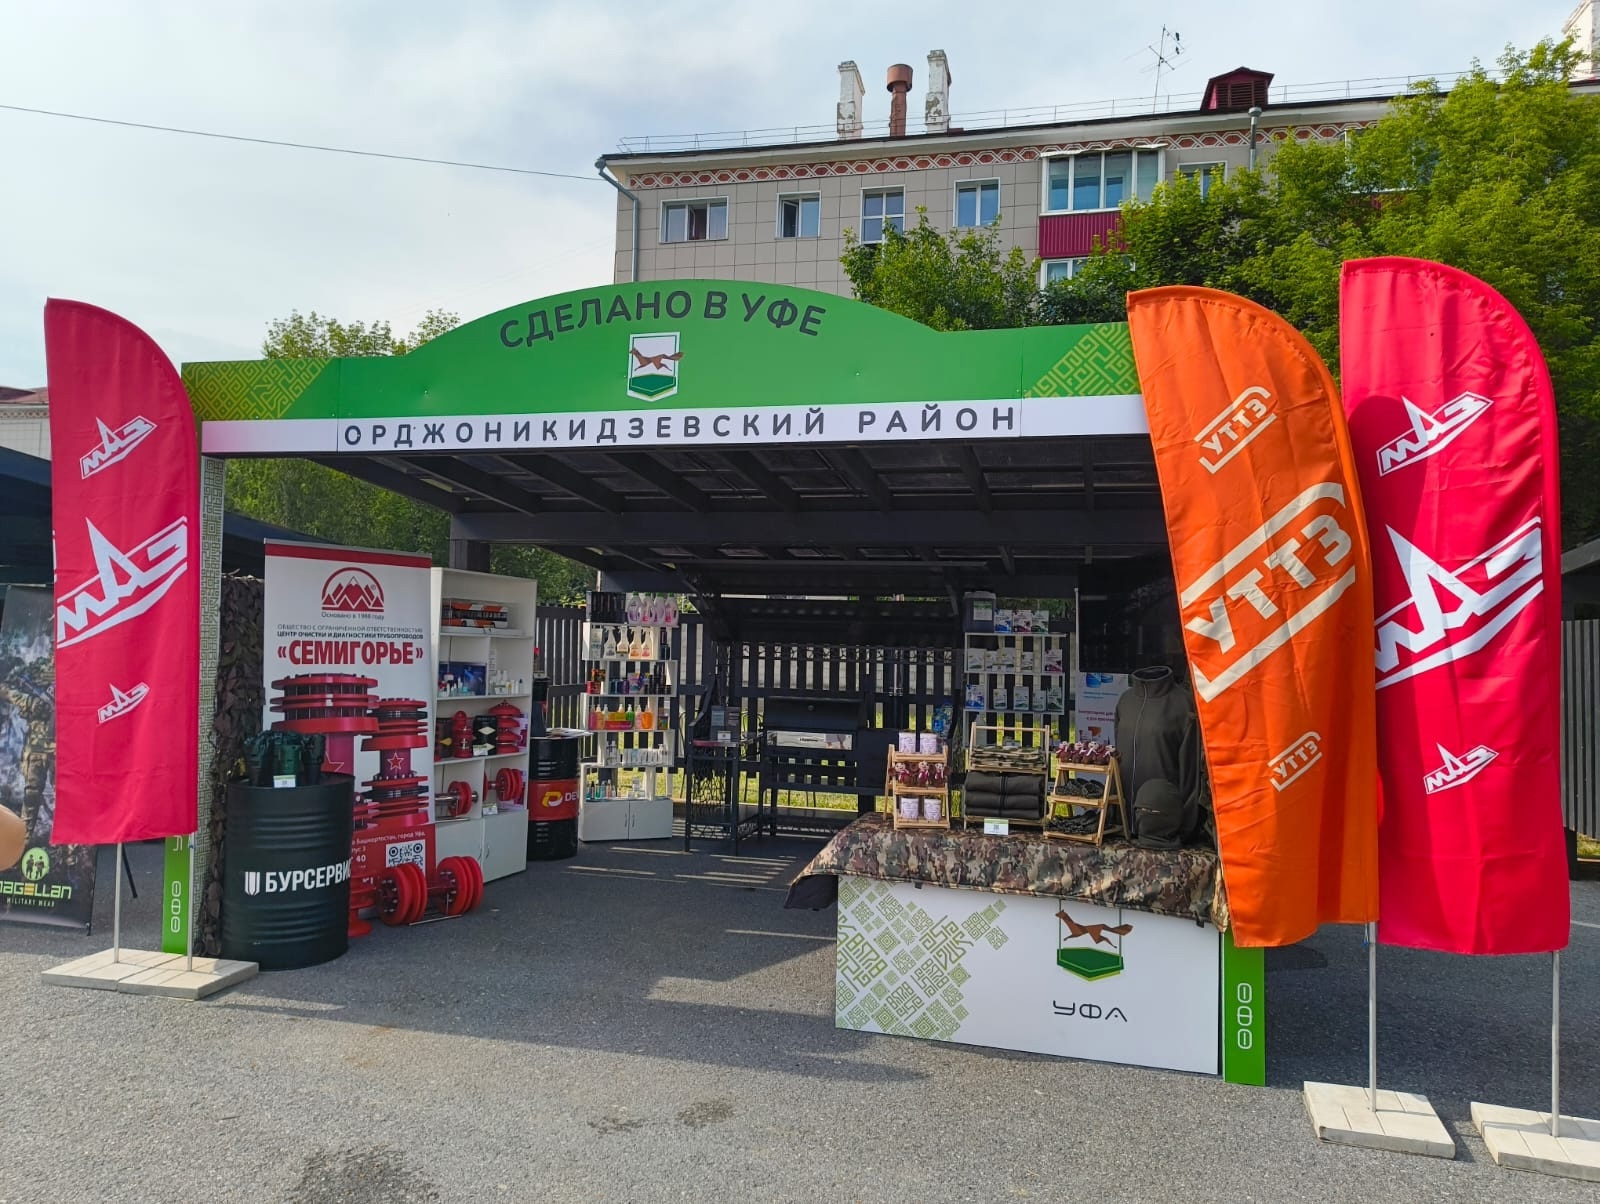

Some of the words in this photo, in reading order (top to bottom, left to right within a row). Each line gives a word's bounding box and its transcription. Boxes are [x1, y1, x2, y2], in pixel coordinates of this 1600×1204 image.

[499, 290, 693, 349] СДЕЛАНО
[704, 293, 727, 320] В
[742, 295, 827, 337] УФЕ
[344, 408, 826, 449] ОРДЖОНИКИДЗЕВСКИЙ
[857, 401, 1015, 434] РАЙОН
[1201, 398, 1267, 456] УТТЗ
[1185, 512, 1355, 656] УТТЗ
[277, 640, 424, 665] «СЕМИГОРЬЕ»
[1272, 740, 1318, 778] УТТЗ
[6, 897, 36, 905] MILITARY
[1052, 999, 1128, 1023] УФА
